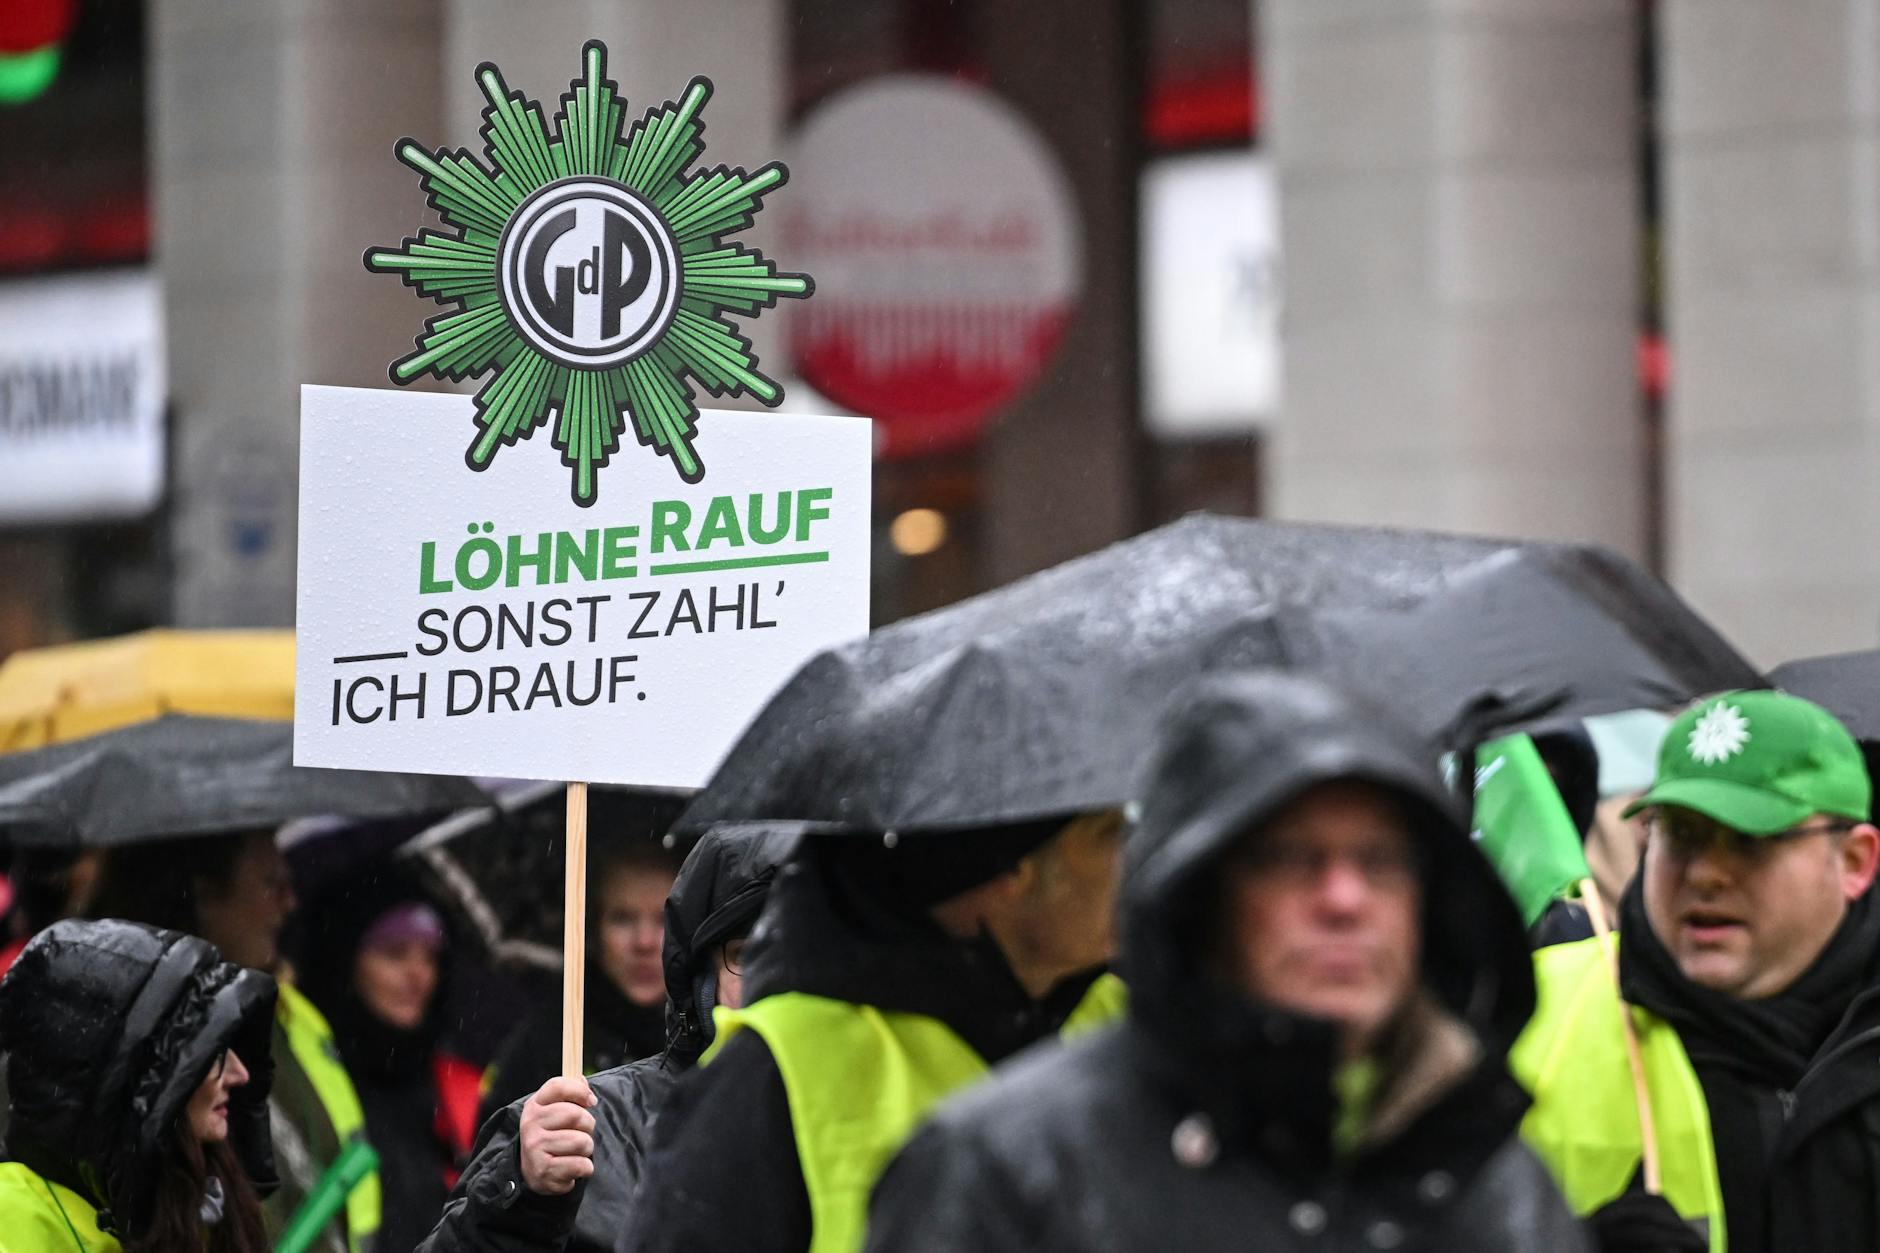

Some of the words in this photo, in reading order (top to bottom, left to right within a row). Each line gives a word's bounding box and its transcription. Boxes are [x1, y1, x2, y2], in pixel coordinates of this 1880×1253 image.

[523, 207, 652, 341] GdP
[418, 520, 640, 595] LÖHNE
[649, 487, 833, 554] RAUF
[627, 580, 786, 640] ZAHL’
[331, 672, 427, 727] ICH
[445, 655, 648, 717] DRAUF.
